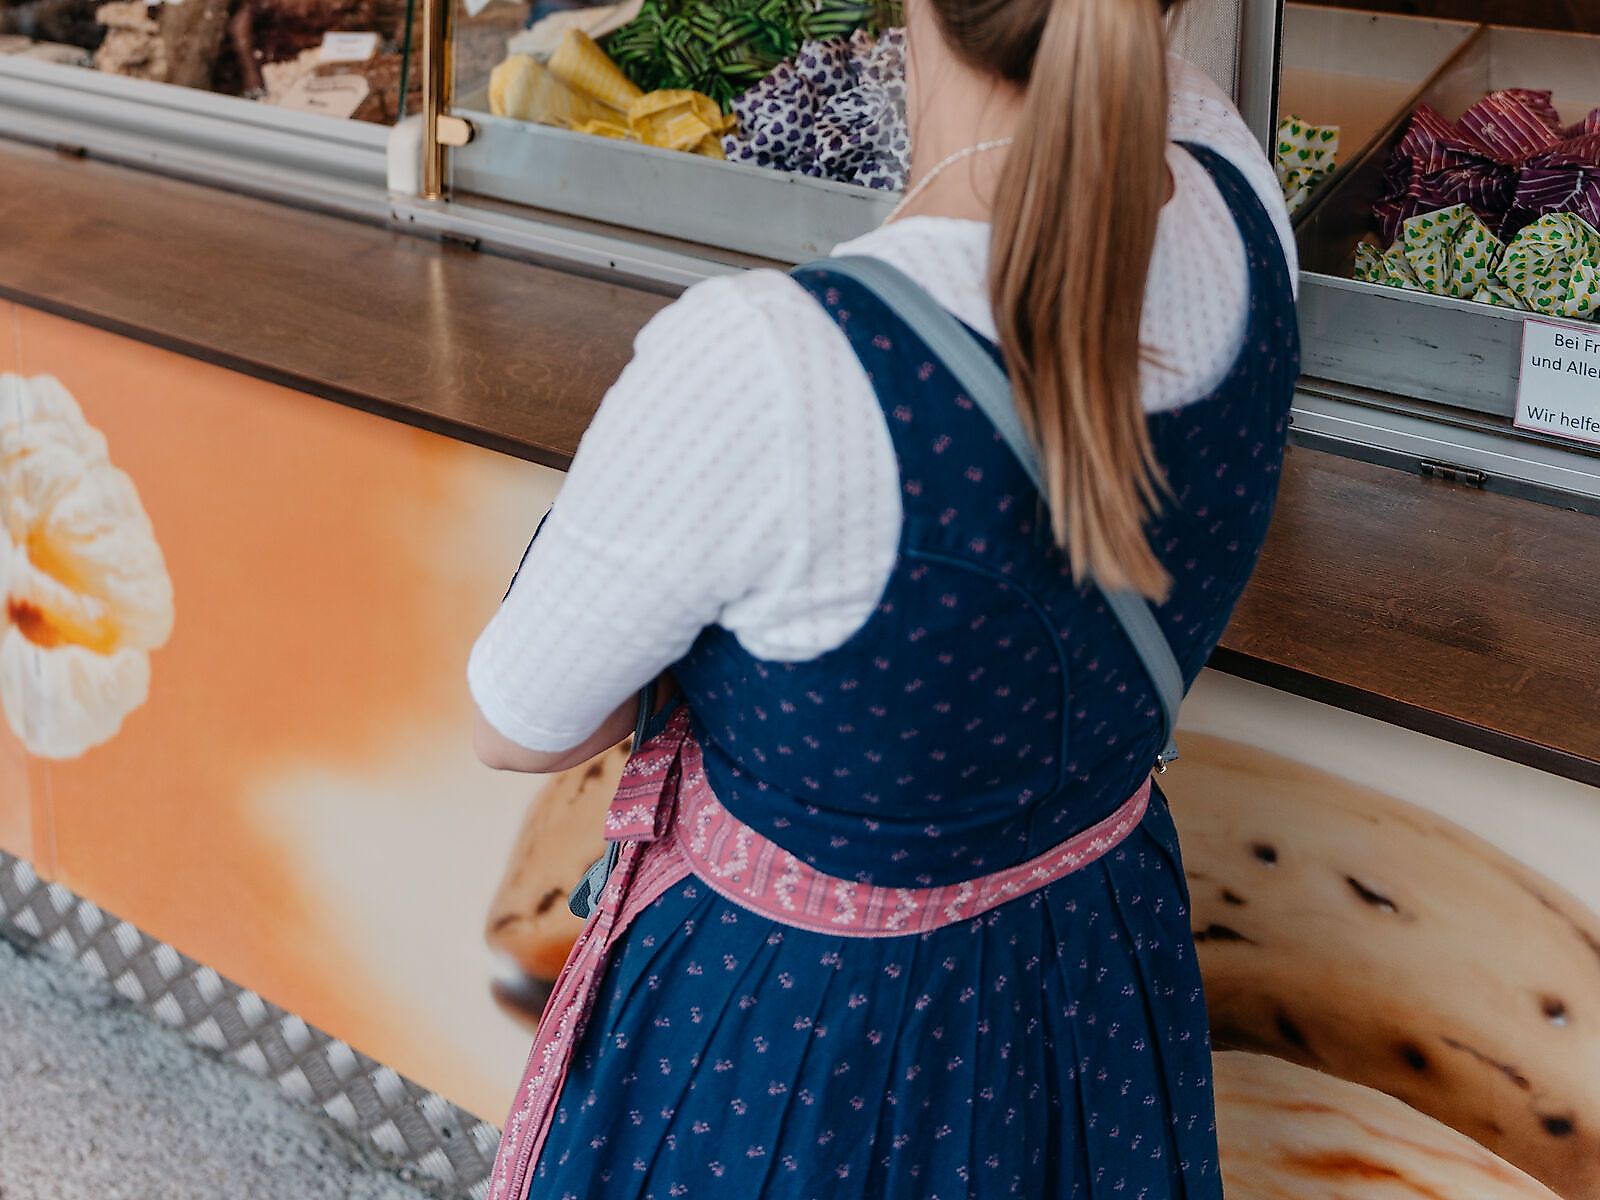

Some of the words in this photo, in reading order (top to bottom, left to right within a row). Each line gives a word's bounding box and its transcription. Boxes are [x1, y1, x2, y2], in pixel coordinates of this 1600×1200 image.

[1554, 333, 1580, 351] Bei
[1531, 355, 1562, 371] und
[1527, 405, 1556, 423] Wir
